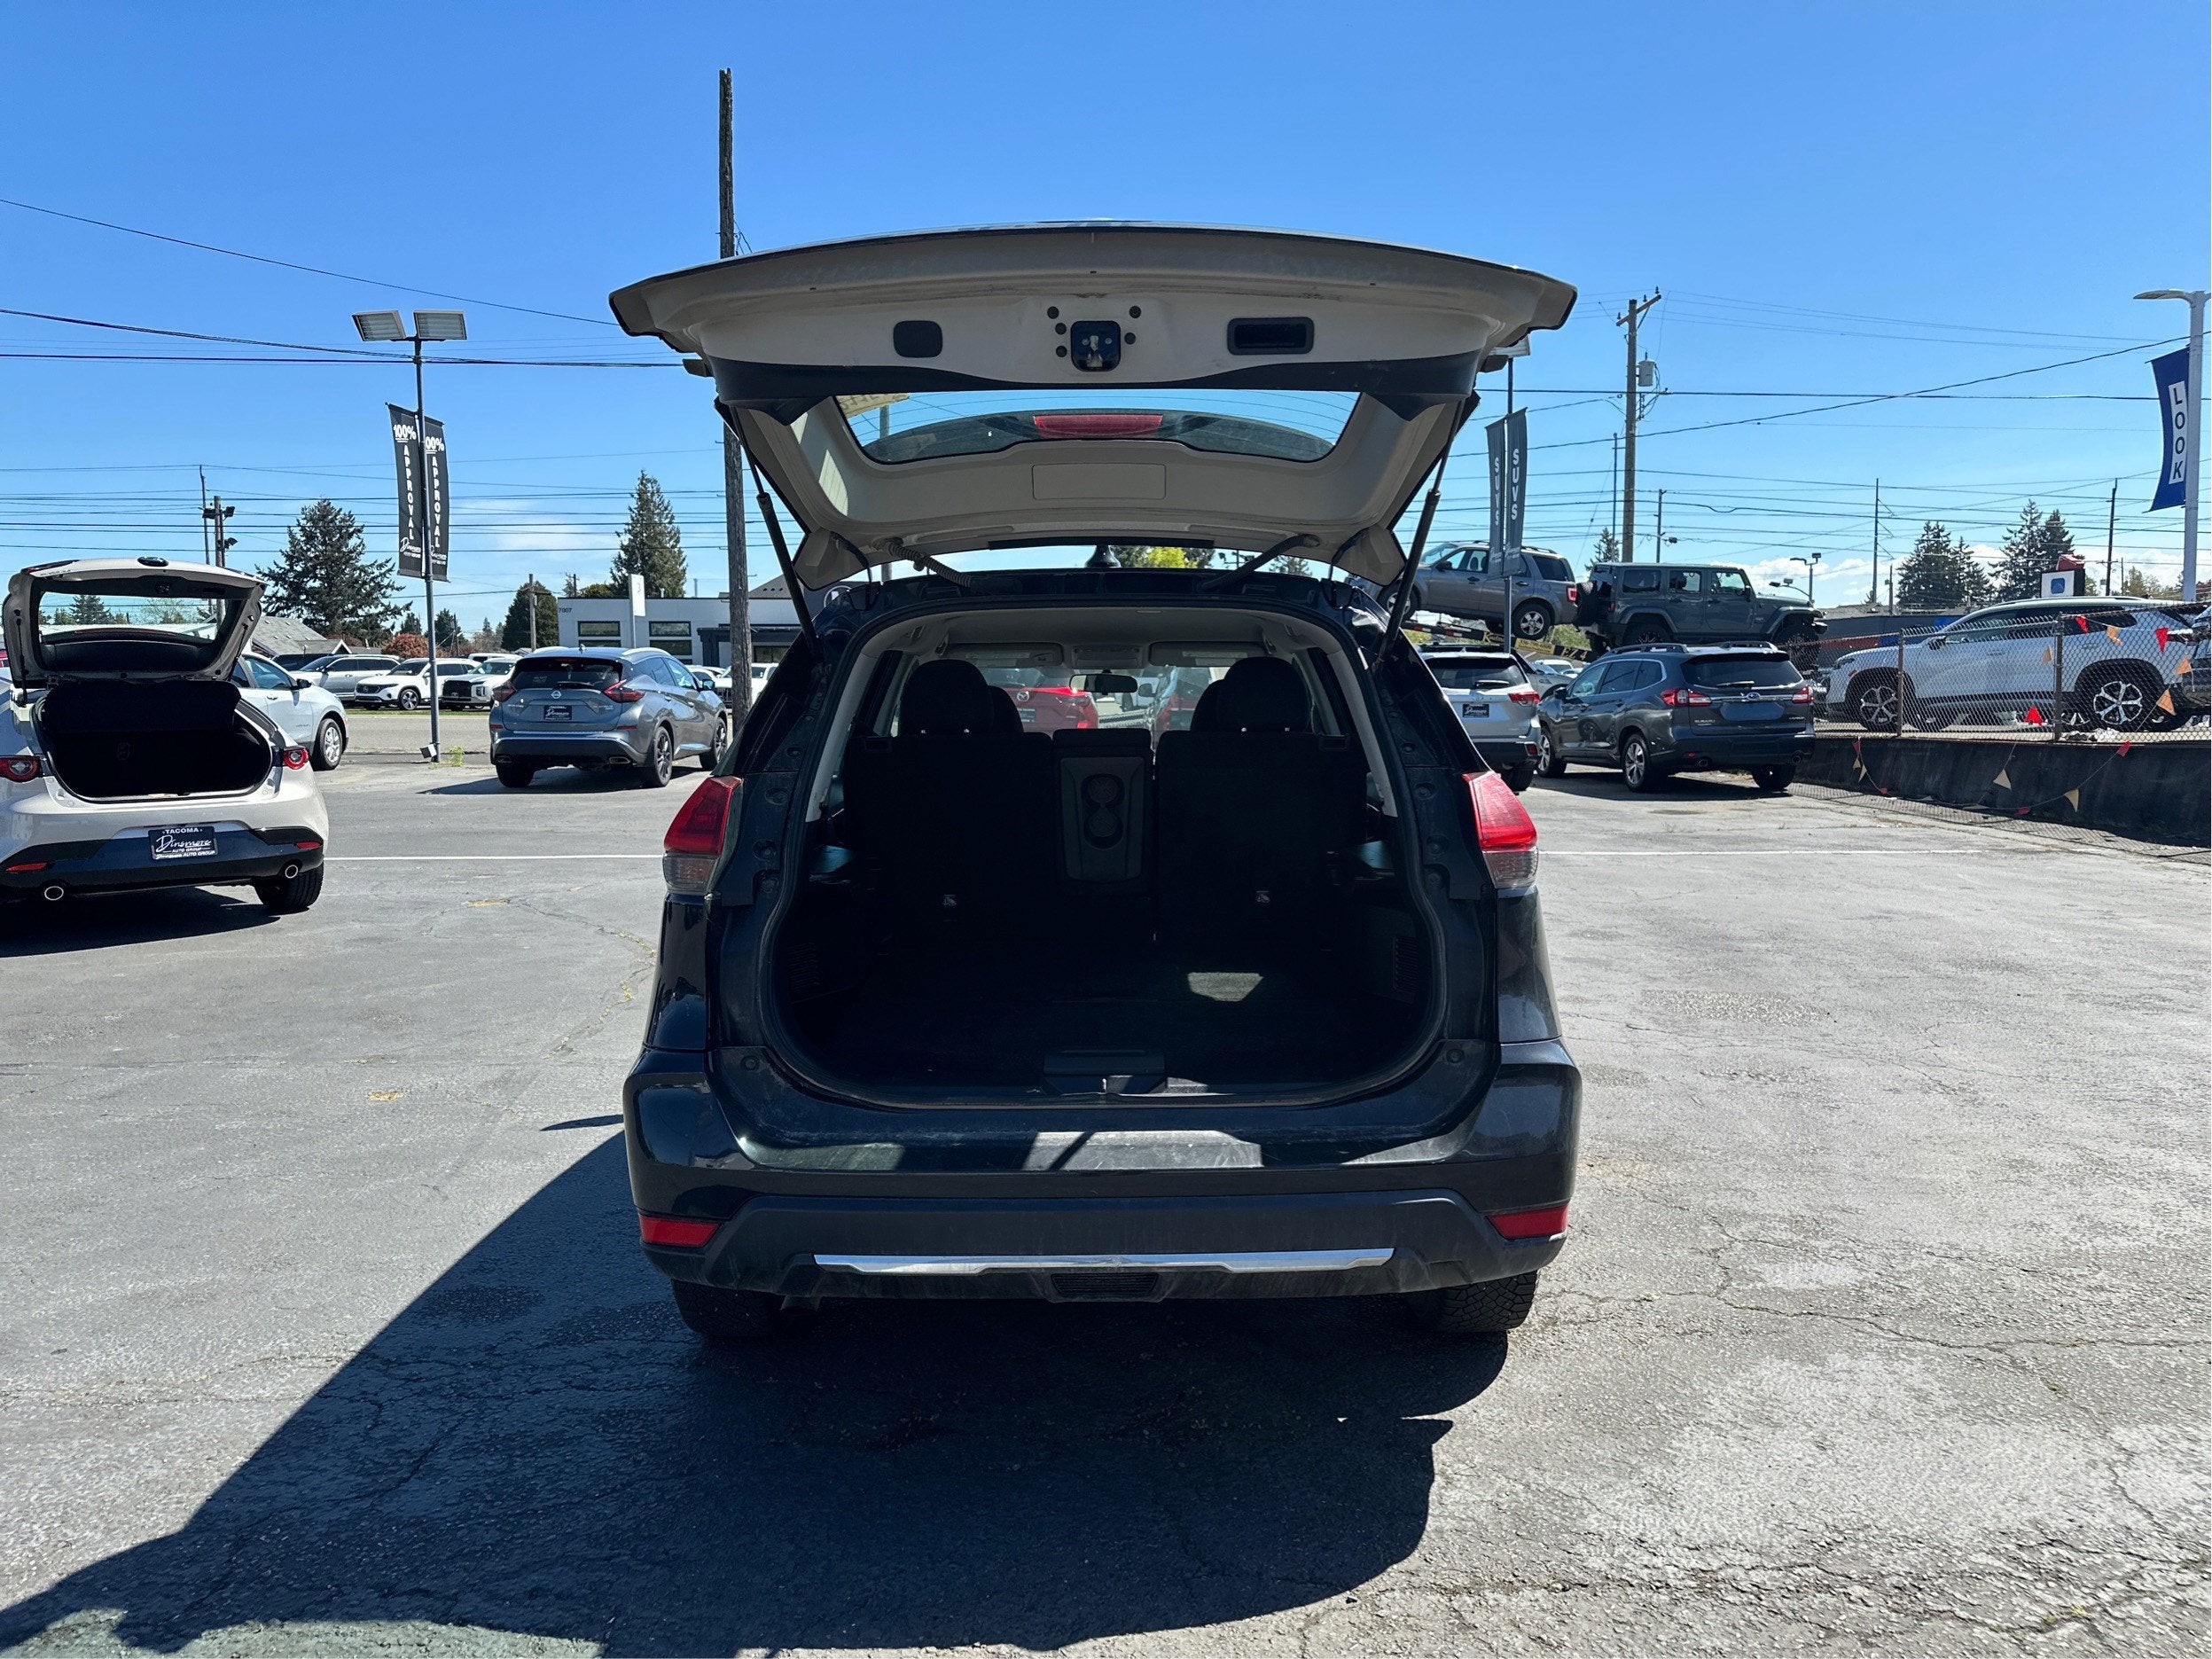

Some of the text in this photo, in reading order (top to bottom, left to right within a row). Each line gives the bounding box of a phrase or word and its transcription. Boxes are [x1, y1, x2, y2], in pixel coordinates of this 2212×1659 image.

[393, 424, 417, 440] 100%
[426, 434, 444, 451] 00%
[2173, 387, 2185, 481] LOOK
[403, 444, 414, 540] APPROVAL
[432, 456, 442, 548] APPROVAL
[1511, 448, 1520, 520] SUVS
[155, 834, 212, 853] Dinsmore
